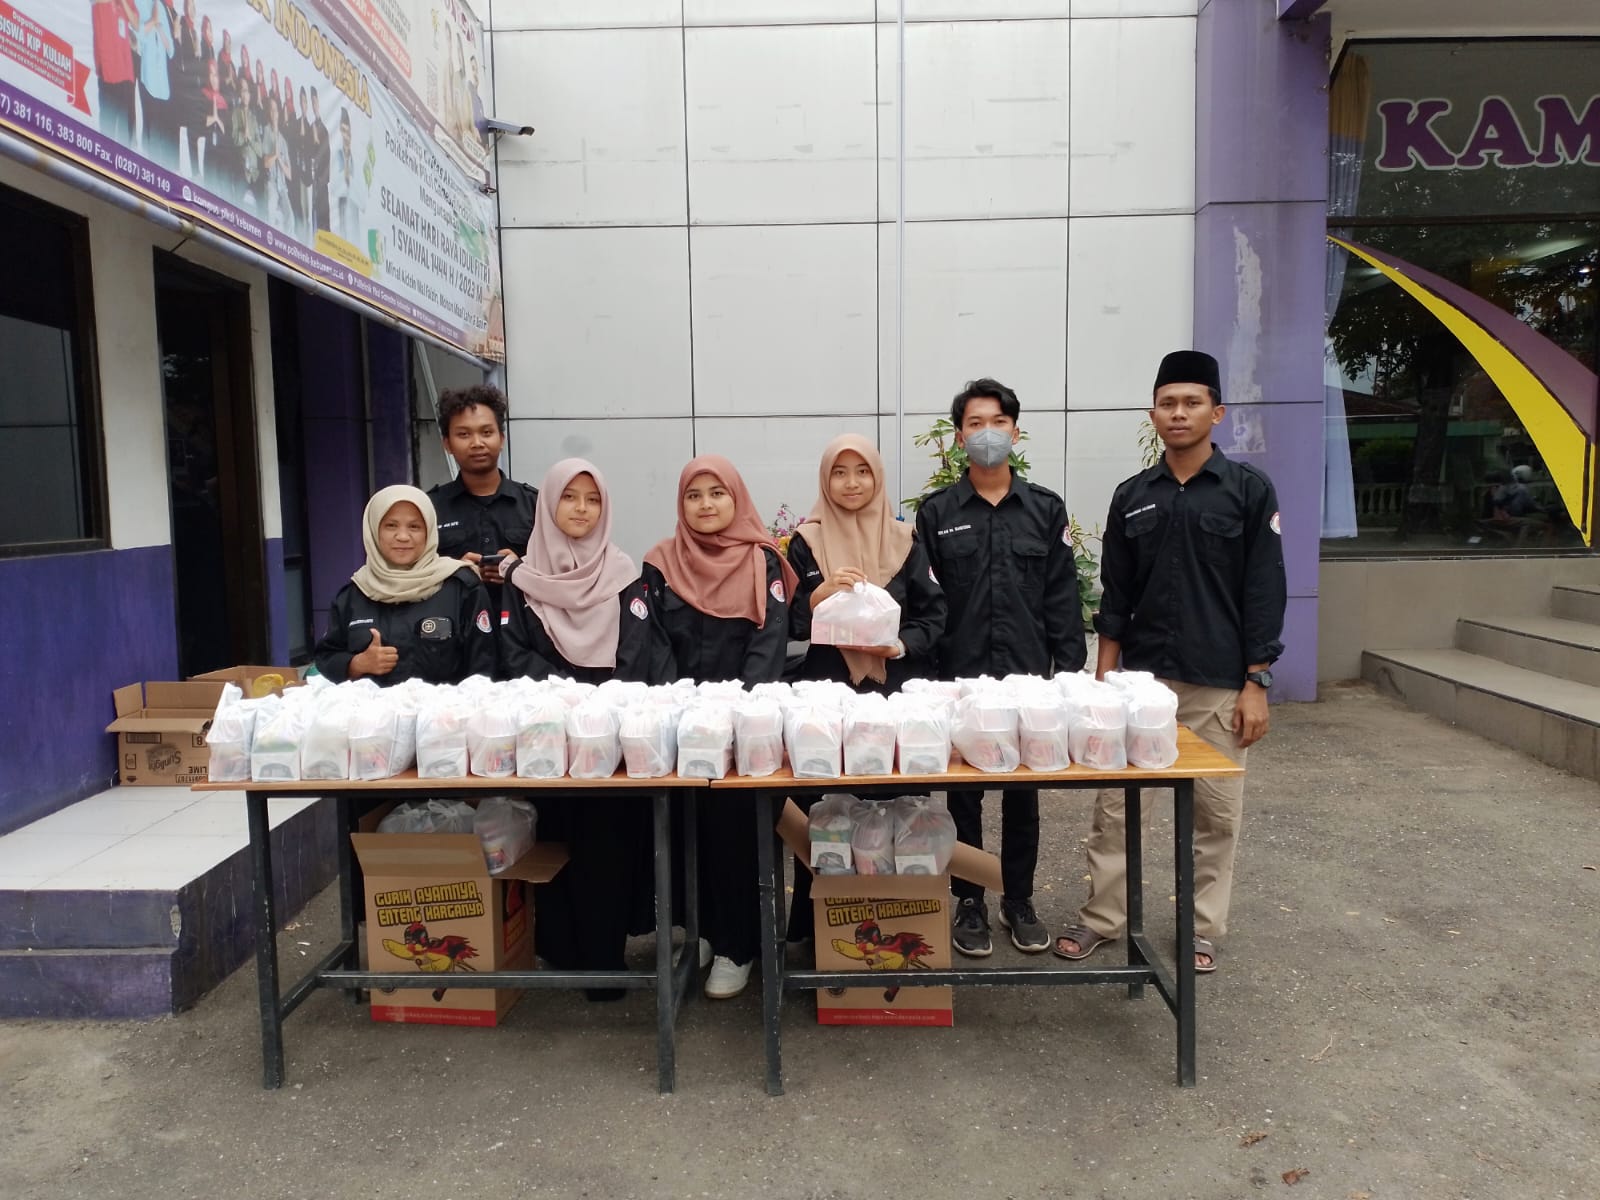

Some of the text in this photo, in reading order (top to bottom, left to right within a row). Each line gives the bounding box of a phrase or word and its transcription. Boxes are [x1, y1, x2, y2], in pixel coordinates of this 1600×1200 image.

[27, 32, 41, 52] KIP
[43, 43, 72, 72] KULIAH
[274, 0, 372, 118] INDONESIA
[13, 101, 31, 122] 381
[35, 112, 54, 136] 116,
[57, 123, 74, 144] 383
[77, 134, 92, 153] 800
[95, 144, 113, 164] Fax.
[115, 153, 140, 179] (0287)
[141, 167, 155, 184] 381
[157, 176, 171, 192] 149
[1375, 95, 1600, 172] KAM
[381, 186, 490, 285] SELAMAT HARI RAYA IDUL FITRI
[392, 225, 396, 248] 1
[398, 229, 429, 270] SYAWAL
[431, 252, 447, 281] 1444
[449, 264, 455, 288] H
[459, 272, 475, 300] 2023
[476, 284, 483, 305] M
[188, 766, 207, 774] LIME
[375, 880, 483, 907] GURIH AYAMNYA,
[378, 902, 485, 927] ENTENG HARGANYA
[827, 904, 874, 927] ENTENG
[876, 899, 941, 921] HARGANYA
